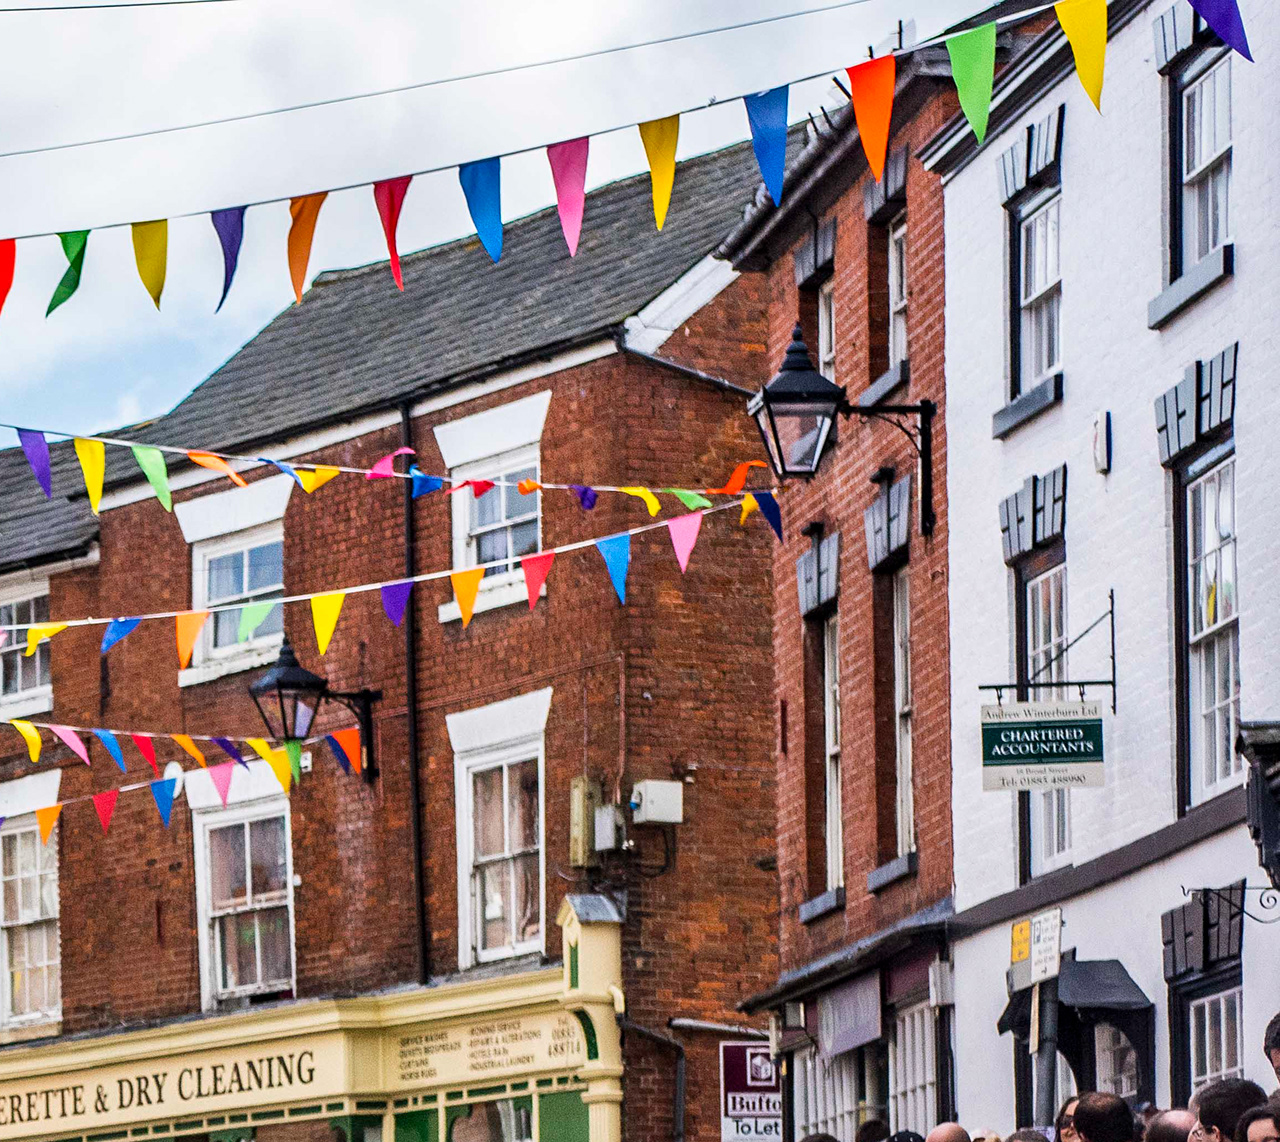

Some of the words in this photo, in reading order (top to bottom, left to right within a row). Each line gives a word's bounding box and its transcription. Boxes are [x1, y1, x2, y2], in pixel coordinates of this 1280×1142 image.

[985, 707, 1019, 719] Andrew
[1023, 706, 1078, 718] Winterburn
[1082, 705, 1098, 717] Ltd
[1000, 727, 1084, 743] CHARTERED
[991, 741, 1094, 756] ACCOUNTANTS
[94, 1083, 109, 1114] &
[117, 1071, 168, 1109] DRY
[177, 1050, 317, 1102] CLEANING
[731, 1094, 782, 1113] Bufto
[732, 1118, 752, 1136] To
[754, 1116, 780, 1136] Let
